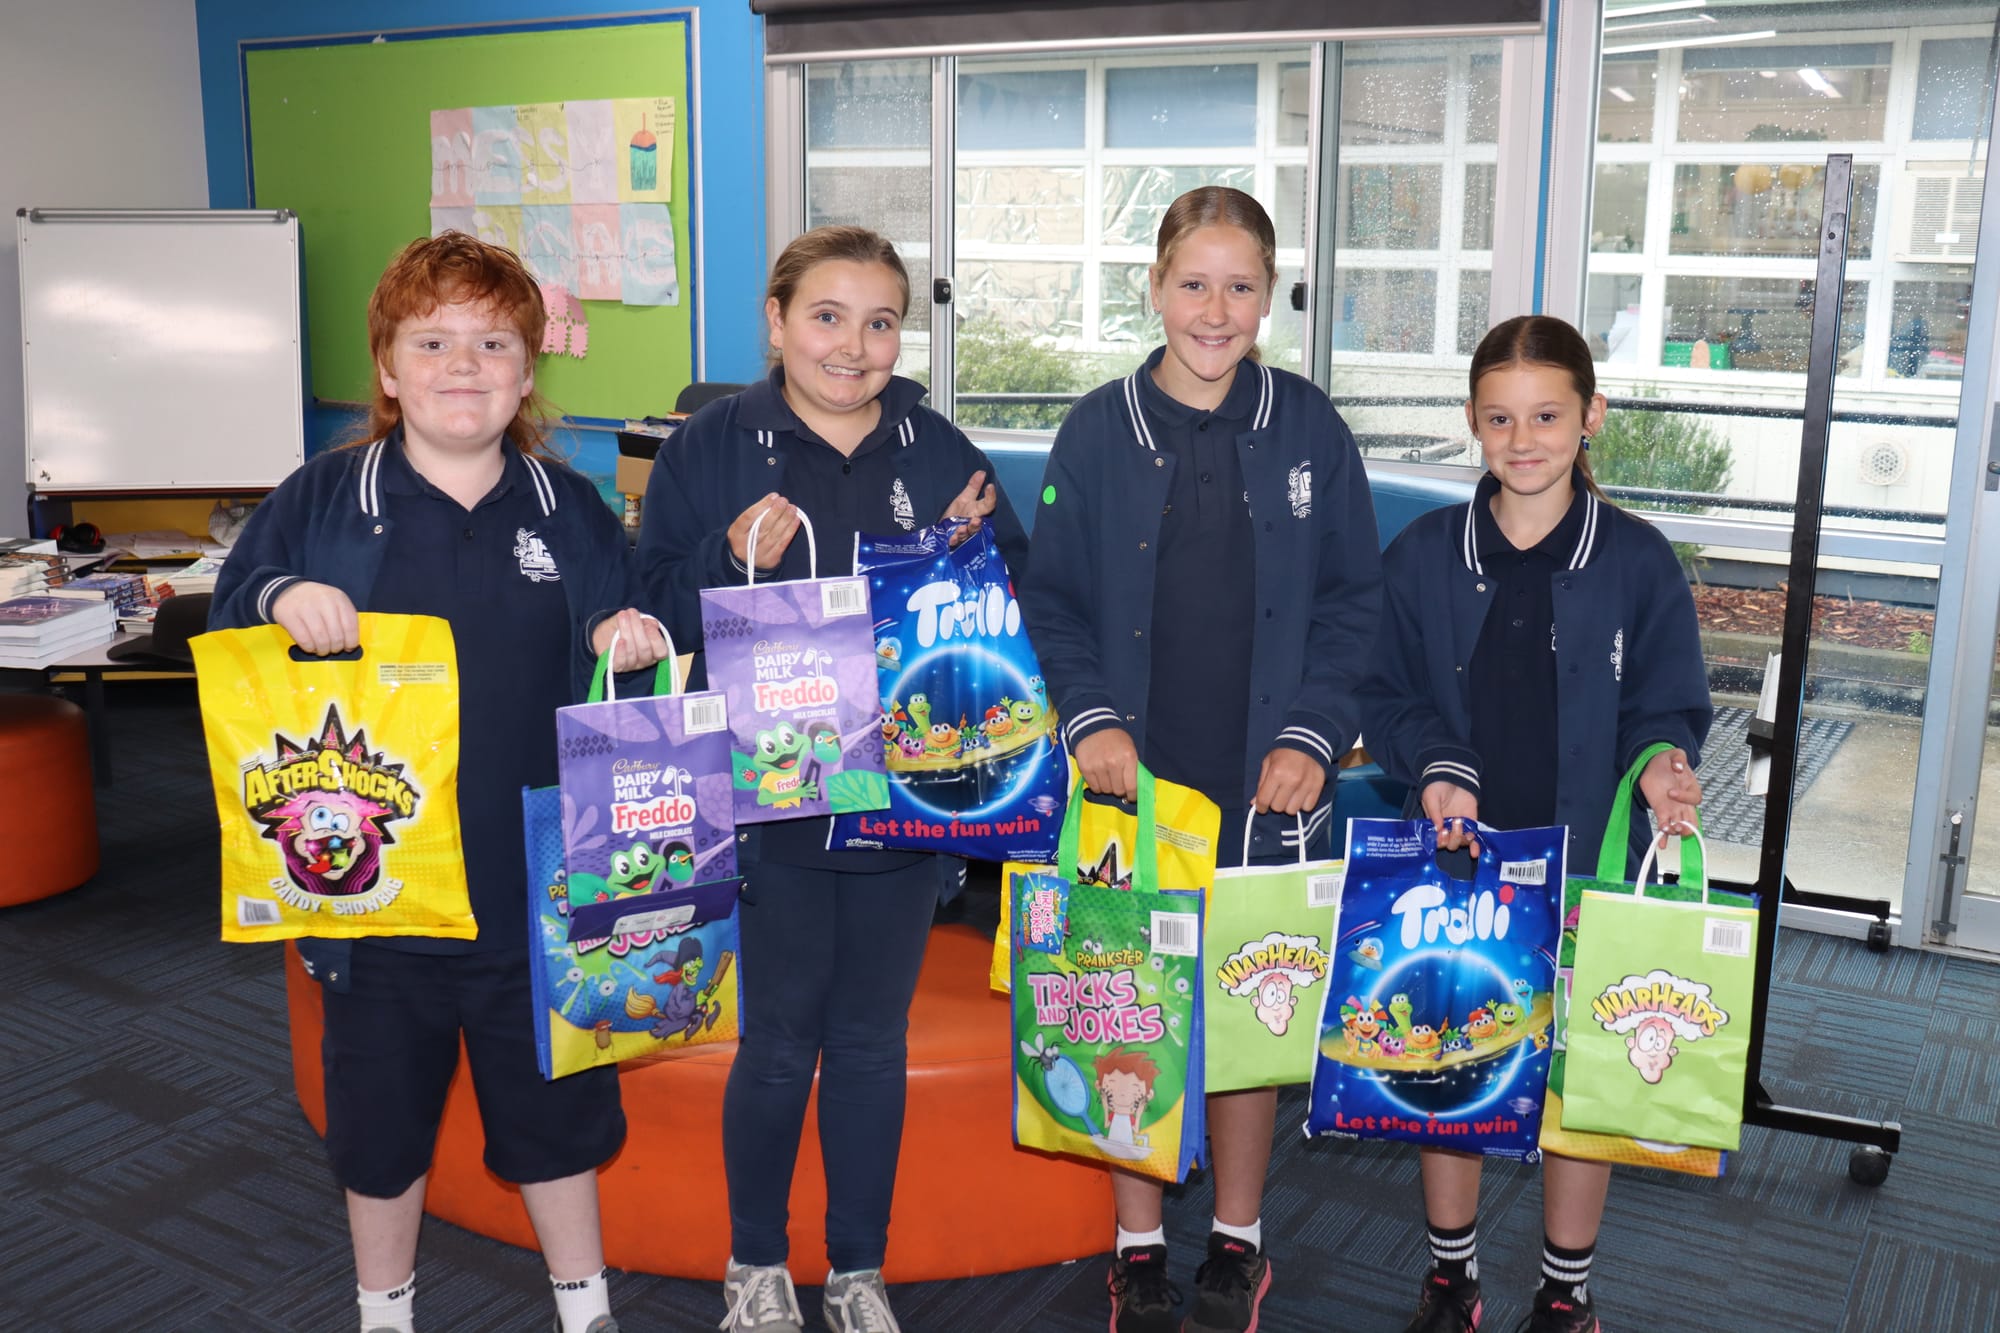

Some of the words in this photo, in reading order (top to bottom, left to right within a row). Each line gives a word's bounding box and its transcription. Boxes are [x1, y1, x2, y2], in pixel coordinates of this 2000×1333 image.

[906, 579, 1021, 648] Trolli
[754, 652, 801, 668] DAIRY
[756, 665, 795, 681] MILK
[756, 678, 835, 709] Freddo
[612, 758, 661, 775] Cadbury
[613, 770, 662, 788] DAIRY
[615, 785, 654, 802] MILK
[615, 798, 692, 829] Freddo
[859, 816, 899, 836] Let
[902, 819, 945, 838] the
[949, 819, 991, 838] fun
[995, 815, 1040, 835] win
[269, 877, 321, 912] CANDY
[1391, 885, 1515, 949] Trolli
[1076, 949, 1143, 968] PRANKSTER
[1217, 943, 1329, 988] WARHEADS
[1028, 970, 1137, 1007] TRICKS
[1036, 1006, 1068, 1026] AND
[1063, 1005, 1166, 1044] JOKES
[1593, 983, 1720, 1037] WARHEADS
[1335, 1112, 1376, 1130] Let
[1379, 1116, 1421, 1133] the
[1426, 1118, 1469, 1135] fun
[1474, 1116, 1518, 1134] win
